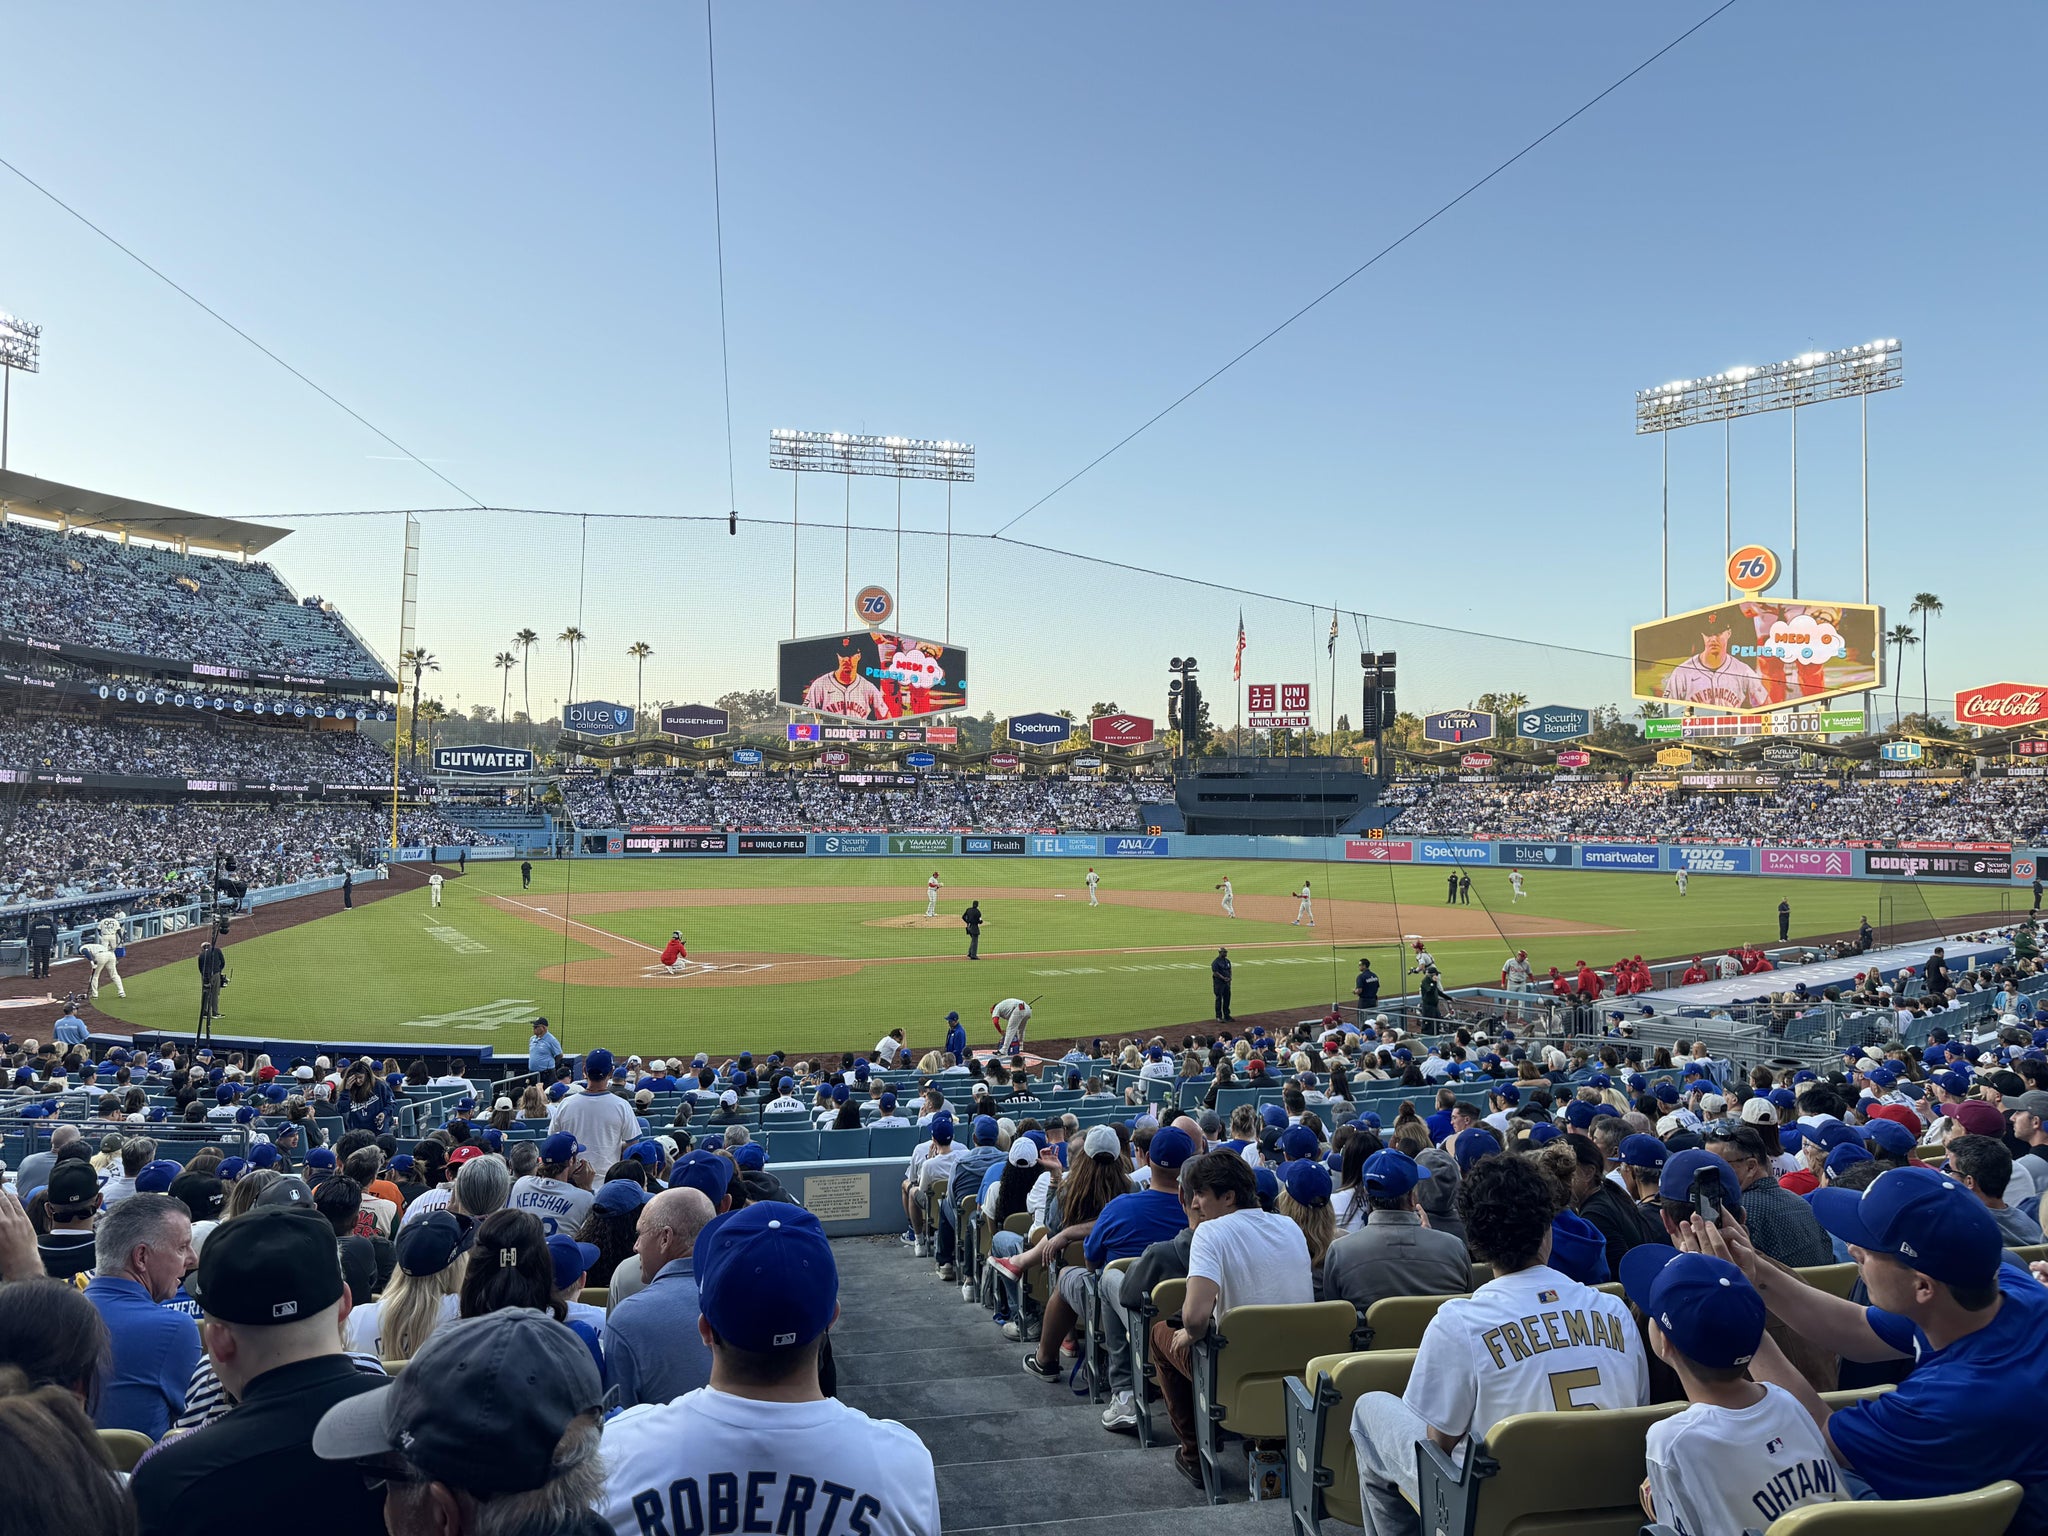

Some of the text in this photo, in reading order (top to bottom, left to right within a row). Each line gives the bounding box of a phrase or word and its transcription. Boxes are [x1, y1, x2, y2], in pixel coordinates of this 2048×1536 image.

[1738, 556, 1765, 580] 76
[863, 596, 886, 613] 76
[193, 663, 250, 679] DODGER HITS
[1252, 687, 1272, 698] ユニ
[1285, 687, 1304, 697] UNI
[1251, 698, 1272, 708] クロ
[1285, 698, 1306, 709] QLO
[1962, 691, 2046, 718] Coca-Cola
[570, 706, 609, 722] blue
[1544, 713, 1583, 725] Security
[576, 721, 614, 730] california
[666, 717, 724, 725] GUGGENHEIM
[1251, 718, 1306, 727] UNIQLO FIELD
[1438, 719, 1478, 729] ULTRA
[1790, 719, 1818, 732] 0 0 0
[825, 728, 894, 740] DODGER HITS
[1015, 722, 1061, 735] Spectrum
[1544, 723, 1579, 734] Benefit
[1660, 750, 1690, 761] JIM BEAM
[1885, 744, 1918, 758] TEL
[440, 751, 526, 768] CUTWATER
[826, 753, 846, 761] JINRO
[1462, 756, 1491, 765] Churu
[1879, 770, 1913, 778] DODGER
[2007, 768, 2043, 776] DODGER
[838, 775, 895, 783] DODGER HITS
[1682, 775, 1752, 785] DODGER HITS
[187, 780, 238, 791] DODGER HITS
[422, 787, 436, 795] 7:19
[610, 841, 620, 849] 76
[627, 839, 697, 849] DODGER HITS
[756, 841, 782, 849] UNIQLO
[842, 838, 870, 847] Security
[969, 841, 1020, 850] UCLA Health
[1034, 839, 1063, 852] TEL
[1118, 839, 1143, 849] ANA
[1424, 845, 1481, 859] Spectrum
[1515, 847, 1544, 859] blue
[1586, 851, 1655, 864] smartwater
[1680, 848, 1725, 860] TOYO
[1769, 853, 1821, 864] DAISO
[1687, 859, 1735, 871] TIRES
[1870, 857, 1969, 872] DODGER HITS
[2014, 863, 2032, 875] 76
[774, 1101, 798, 1109] OHTANI
[516, 1192, 573, 1216] KERSHAW
[1482, 1309, 1626, 1370] FREEMAN
[1752, 1458, 1837, 1522] OHTANI
[631, 1470, 882, 1536] ROBERTS
